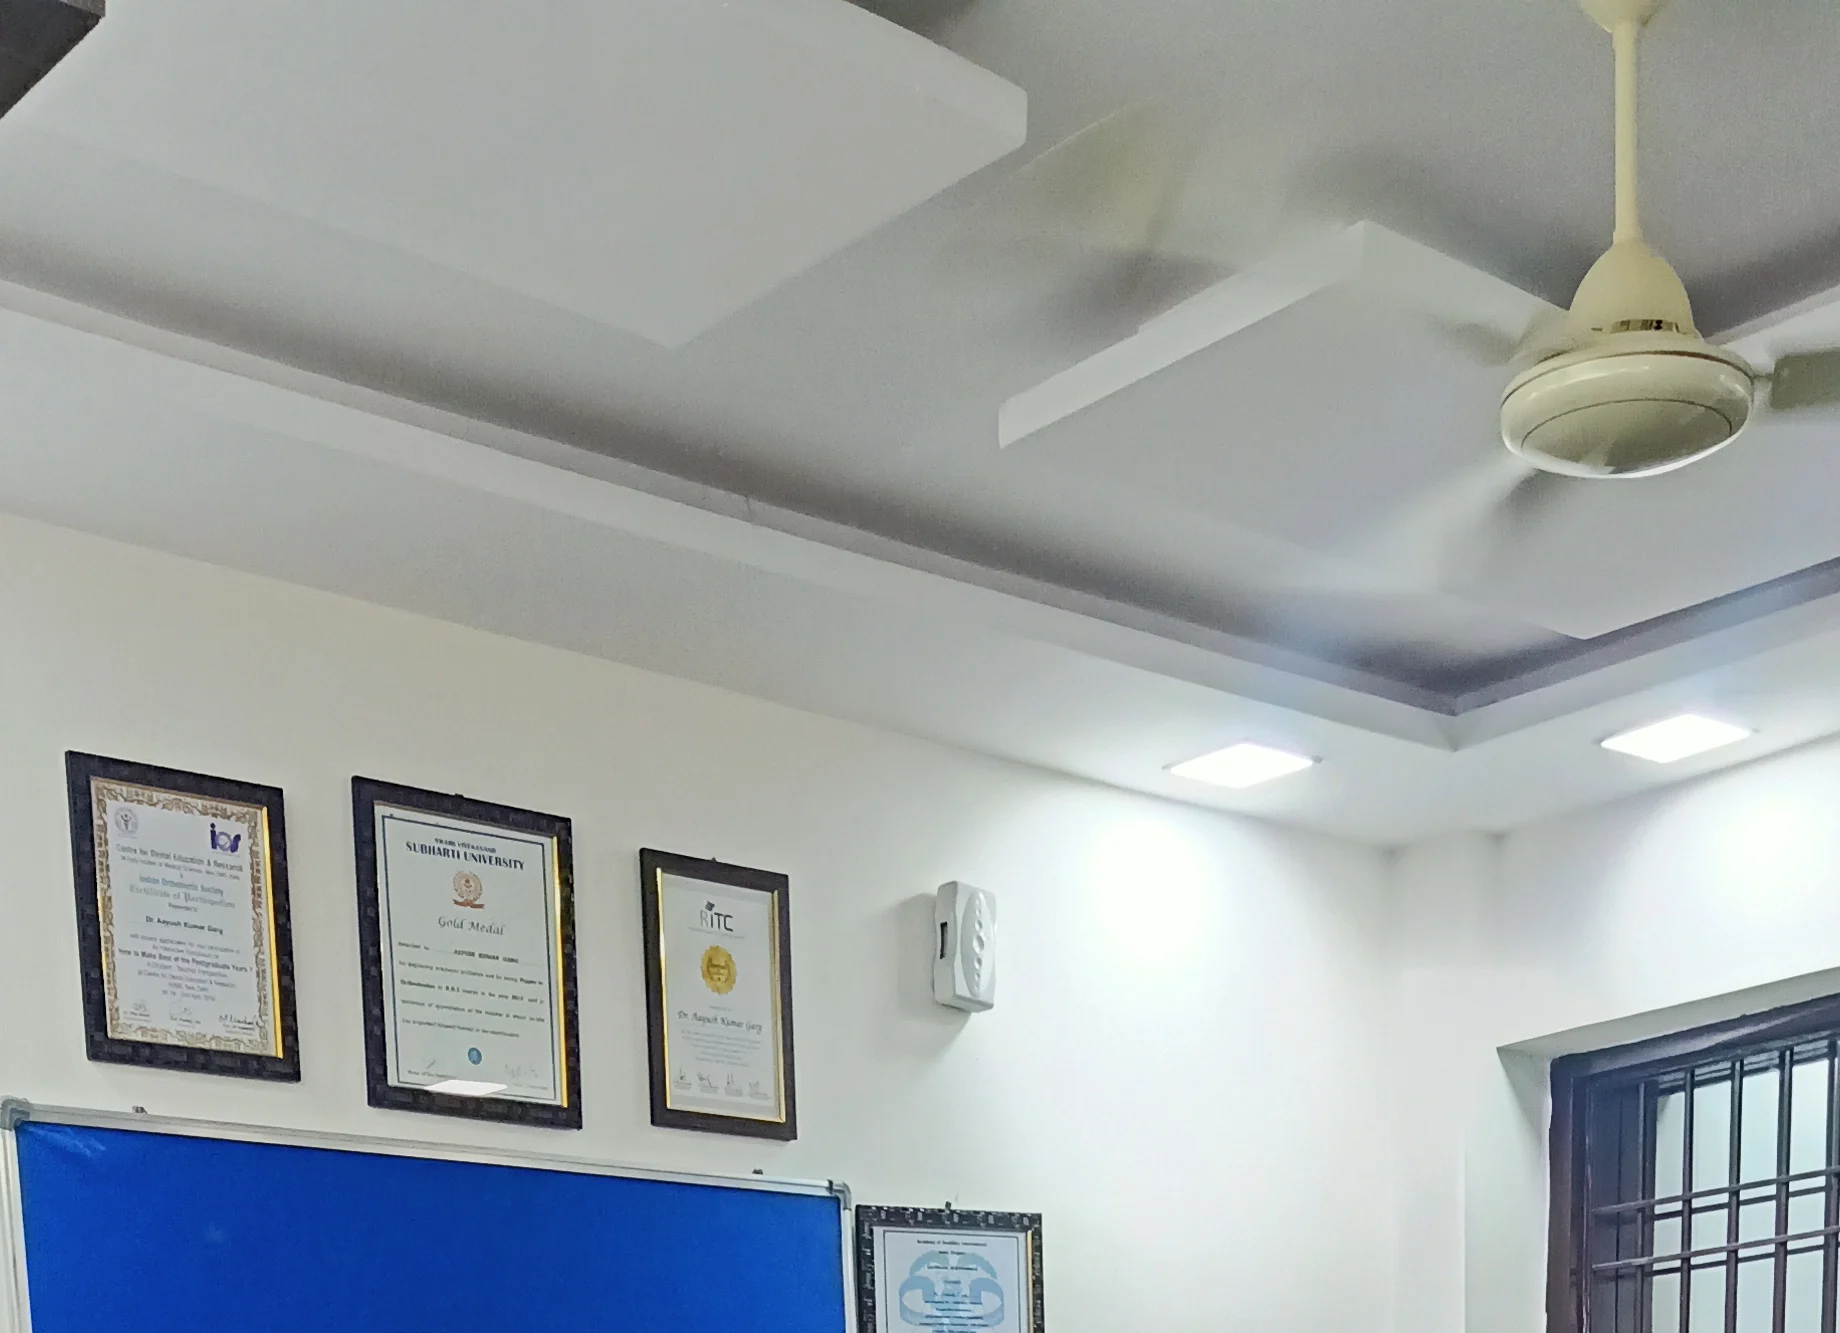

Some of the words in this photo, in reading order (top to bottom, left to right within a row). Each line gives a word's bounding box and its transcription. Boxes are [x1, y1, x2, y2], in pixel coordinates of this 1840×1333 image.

[405, 840, 462, 861] SUBHARTI
[463, 851, 525, 871] UNIVERSITY
[438, 916, 466, 930] Gold
[467, 920, 507, 936] Medal
